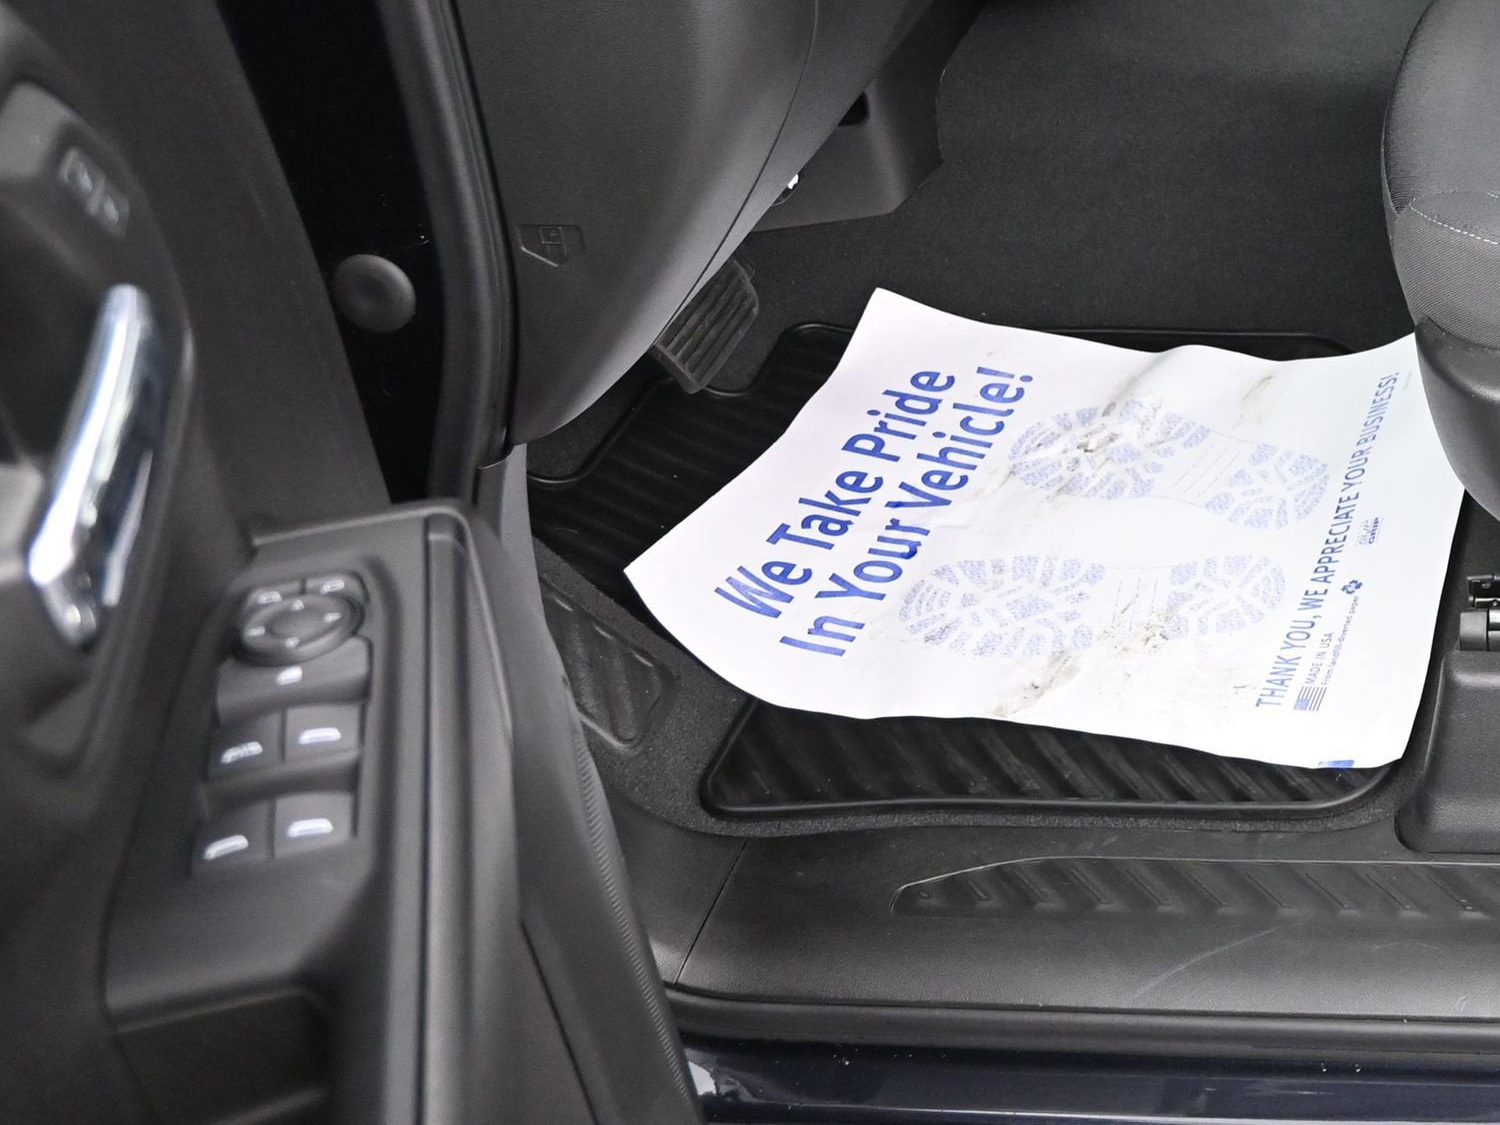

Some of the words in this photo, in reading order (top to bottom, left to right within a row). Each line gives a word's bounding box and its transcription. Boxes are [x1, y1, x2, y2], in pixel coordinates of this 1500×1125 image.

[1356, 372, 1399, 446] BUSINESS!
[885, 366, 1033, 508] Vehicle!
[1341, 446, 1372, 492] YOUR
[714, 560, 812, 618] We
[766, 471, 883, 550] Take
[841, 371, 955, 462] Pride
[815, 518, 930, 600] Your
[1310, 492, 1359, 584] APPRECIATE
[1297, 589, 1328, 613] WE
[779, 616, 865, 656] In
[1280, 615, 1322, 650] YOU,
[1315, 651, 1326, 660] IN
[1320, 632, 1333, 649] USA
[1256, 655, 1301, 707] THANK
[1305, 663, 1323, 684] MADE
